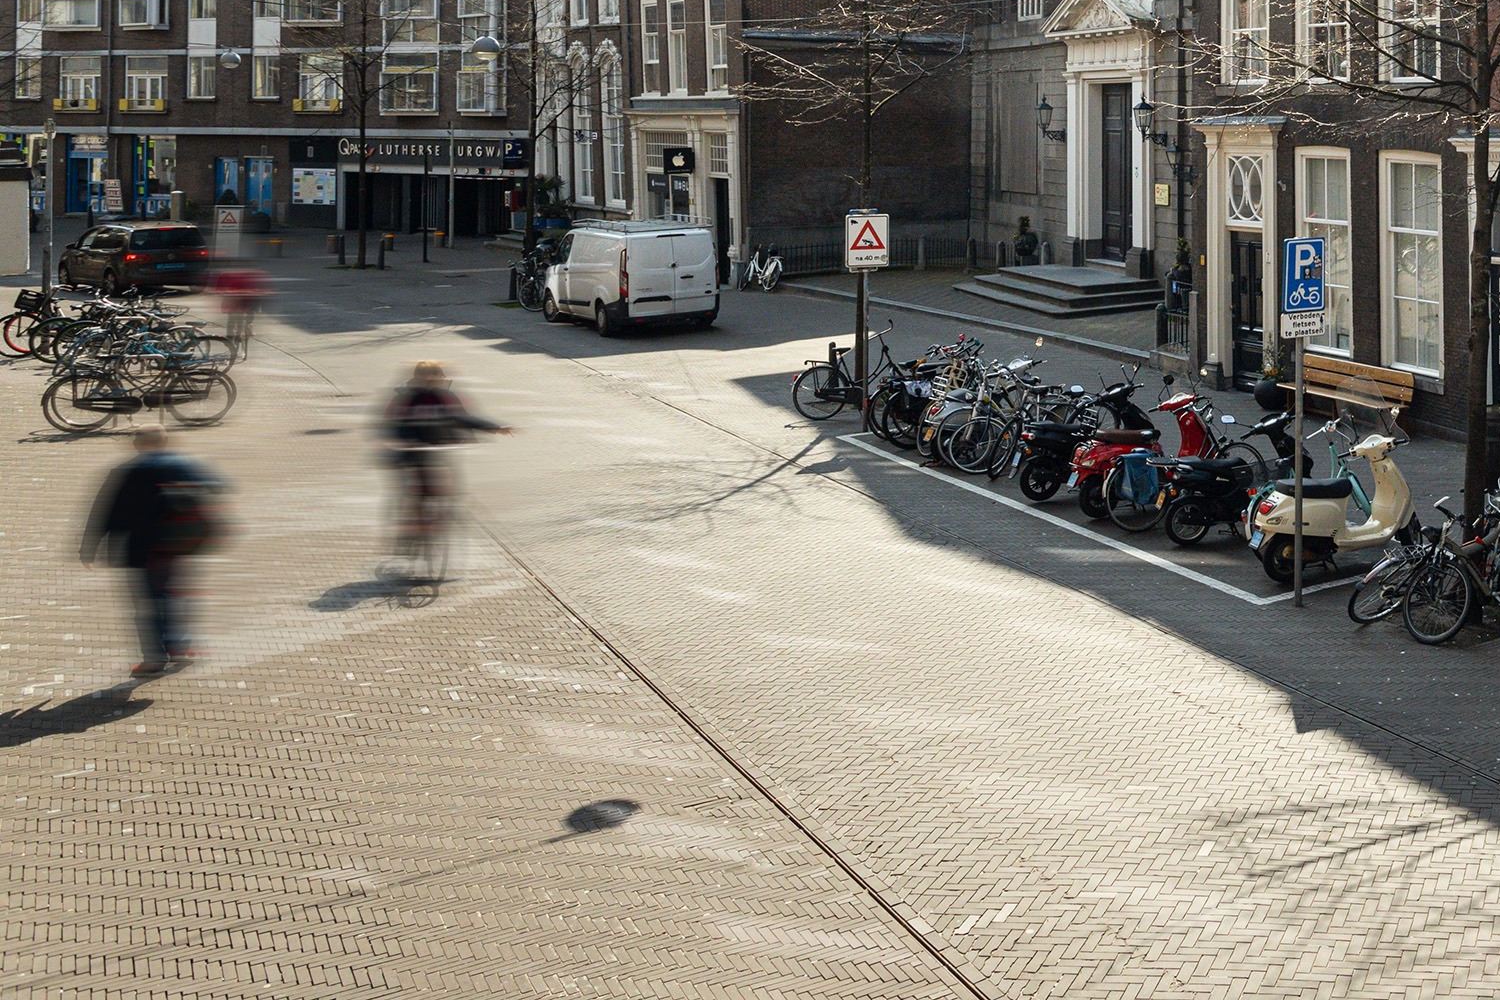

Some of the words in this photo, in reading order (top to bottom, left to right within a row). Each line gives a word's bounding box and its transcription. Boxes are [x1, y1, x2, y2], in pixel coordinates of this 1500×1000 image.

[379, 143, 440, 156] LUTHERSE
[1294, 243, 1316, 280] P
[1288, 311, 1320, 321] Verboden
[1292, 320, 1317, 329] fietsen
[1294, 327, 1324, 337] plaatsen
